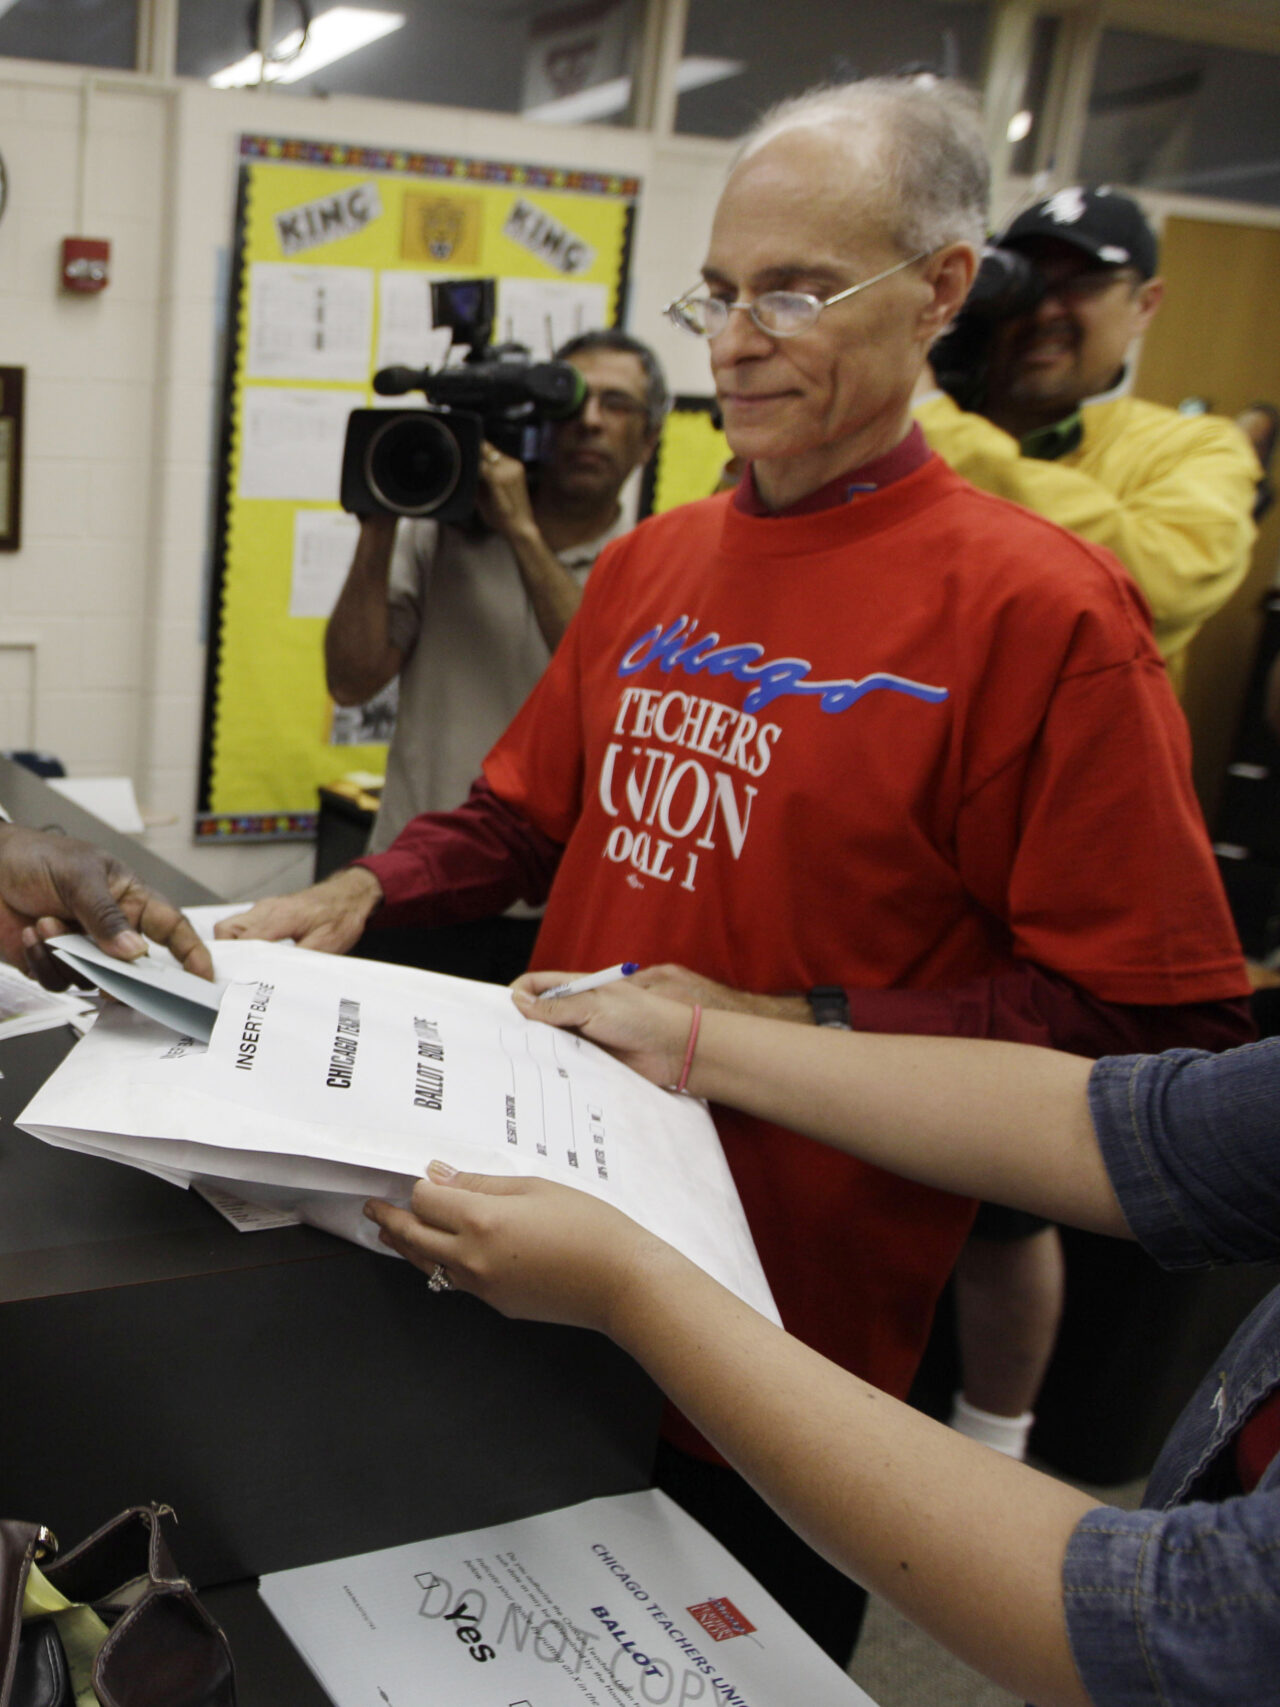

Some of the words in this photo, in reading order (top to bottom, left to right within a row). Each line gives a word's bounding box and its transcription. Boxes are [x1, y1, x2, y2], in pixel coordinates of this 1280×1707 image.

[277, 190, 371, 247] KING
[511, 199, 582, 272] KING
[235, 1012, 264, 1071] INSERT
[326, 1035, 358, 1089] CHICAGO
[414, 1062, 444, 1111] BALLOT
[419, 1575, 487, 1630] DO
[497, 1602, 600, 1674] NOT
[443, 1602, 496, 1662] Yes
[590, 1605, 664, 1678] BALLOT
[591, 1543, 650, 1601] CHICAGO
[646, 1602, 717, 1675] TEACHERS
[712, 1677, 751, 1707] UNI
